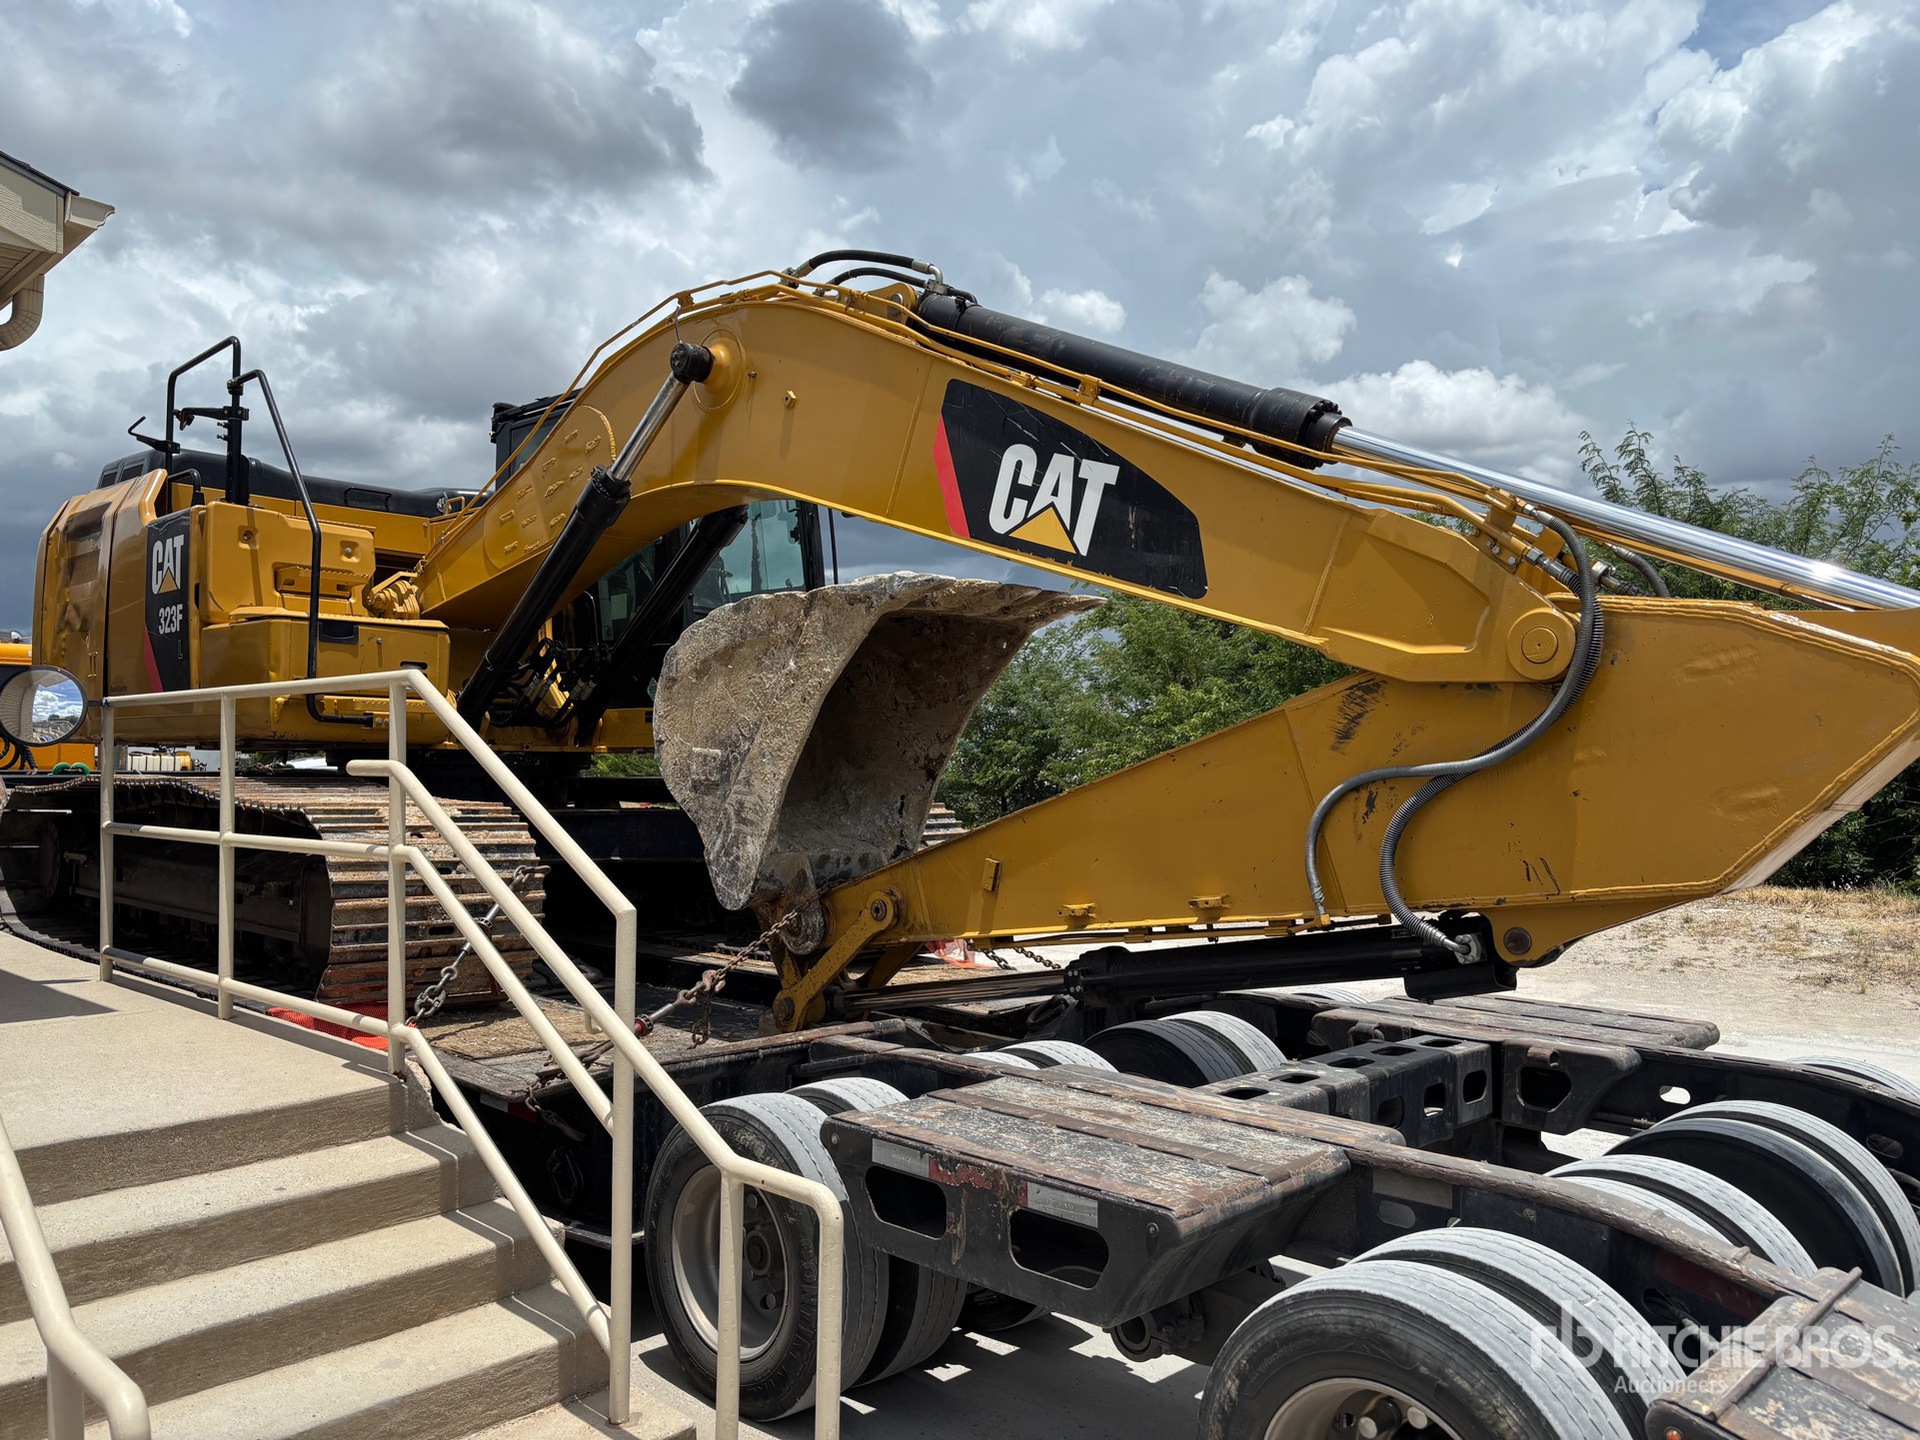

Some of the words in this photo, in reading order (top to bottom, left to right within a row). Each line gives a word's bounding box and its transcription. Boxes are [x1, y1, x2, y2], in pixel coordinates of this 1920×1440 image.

[989, 443, 1120, 556] CAT
[151, 534, 184, 594] CAT
[159, 603, 183, 635] 323F
[177, 640, 183, 659] L
